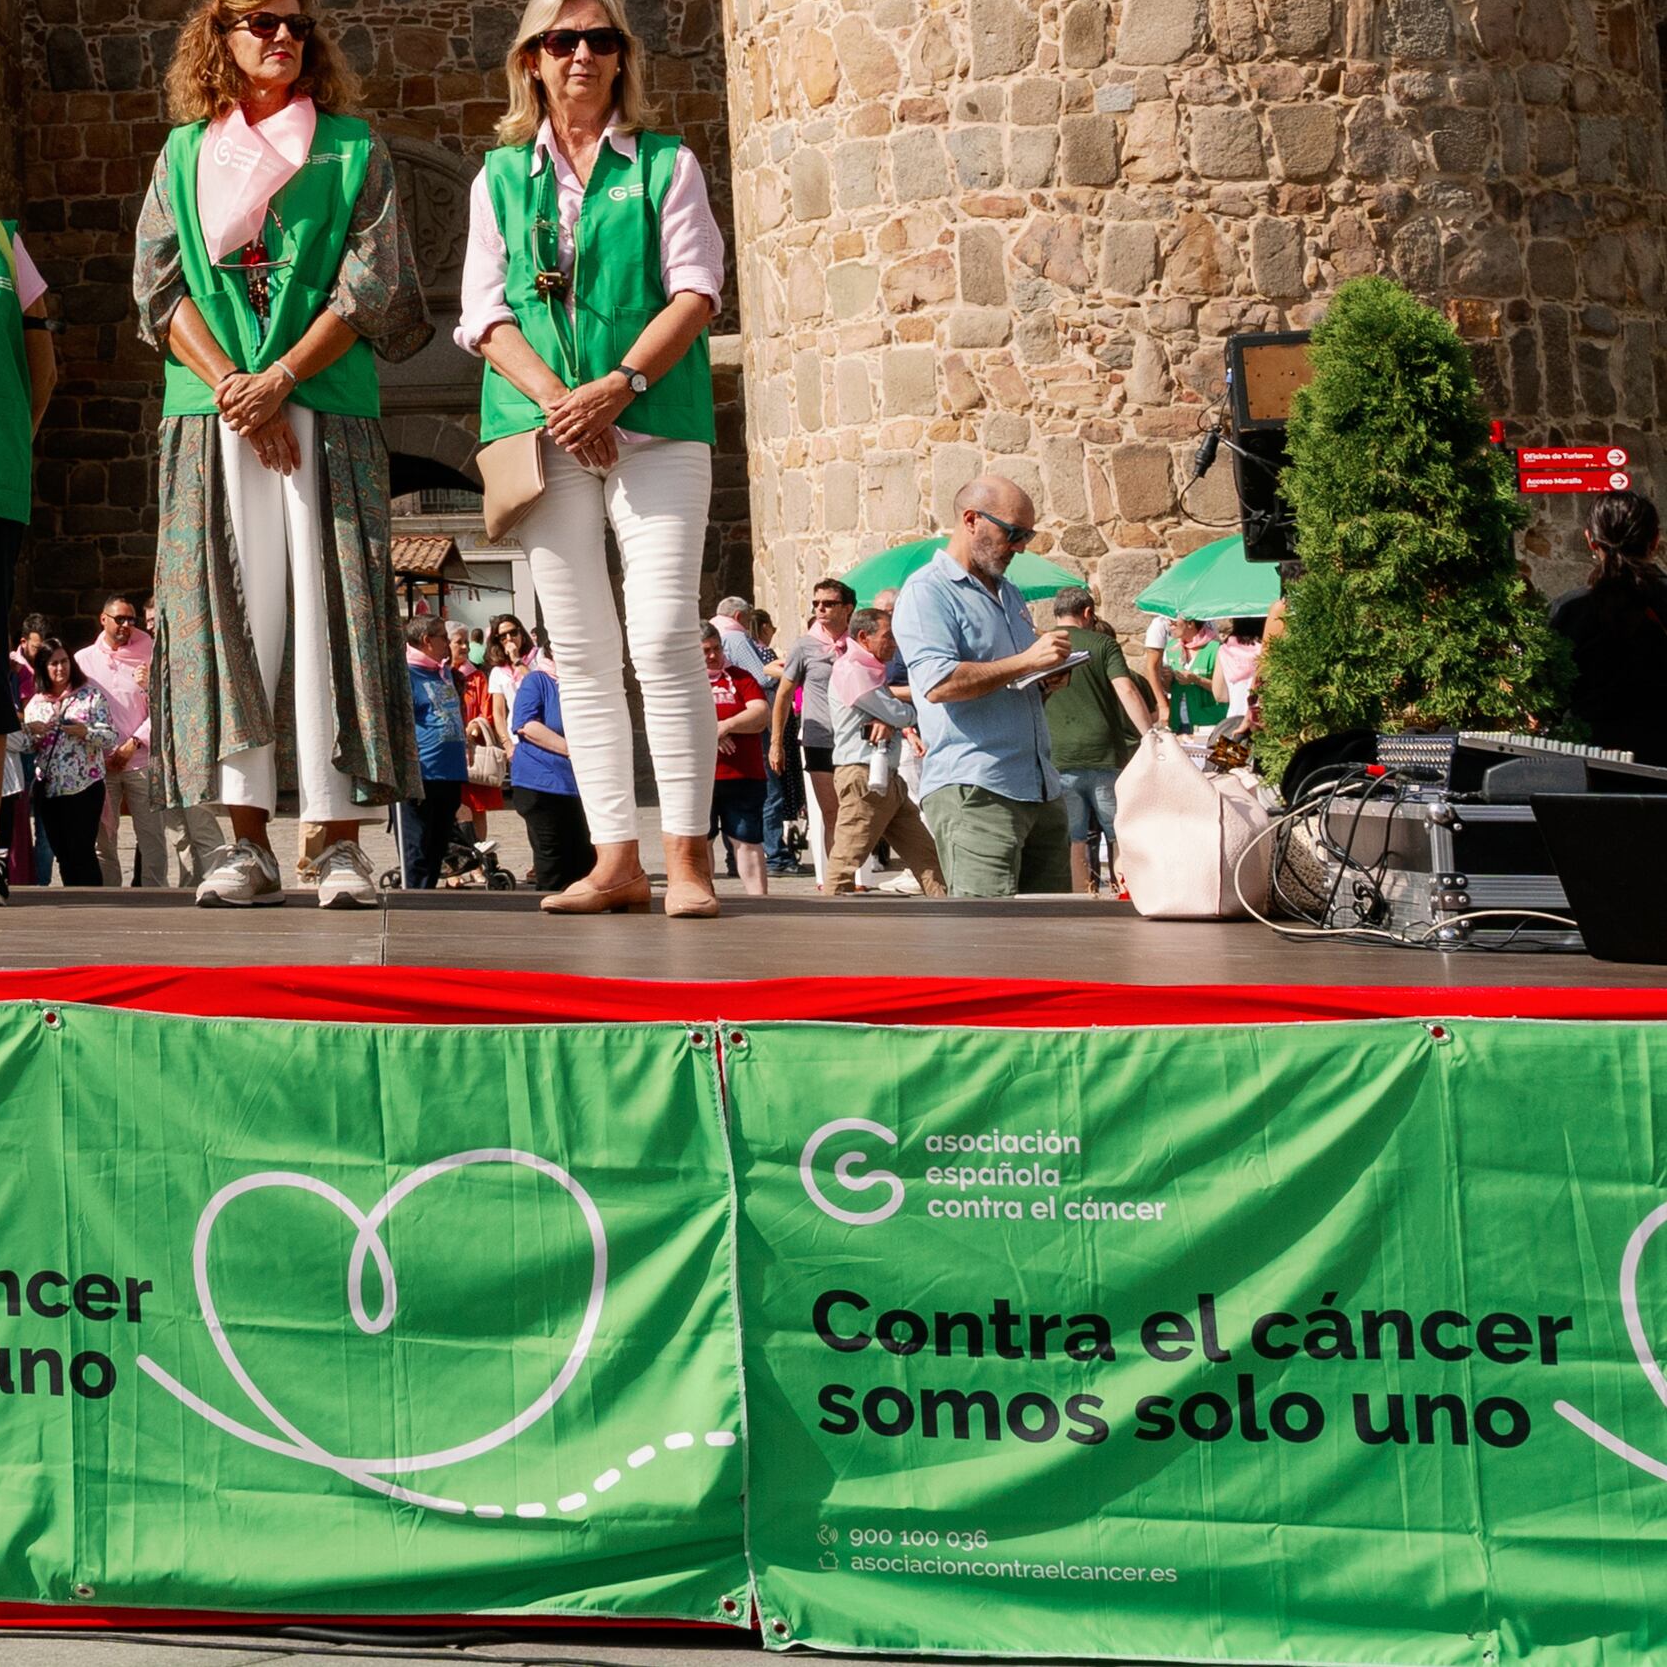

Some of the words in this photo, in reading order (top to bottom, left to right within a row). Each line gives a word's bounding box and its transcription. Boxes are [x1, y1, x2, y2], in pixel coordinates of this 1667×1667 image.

[925, 1128, 1081, 1155] asociación
[925, 1161, 1060, 1192] española
[927, 1195, 1023, 1220] contra
[1030, 1195, 1056, 1220] el
[1063, 1196, 1169, 1222] cáncer
[812, 1290, 1116, 1362] Contra
[1141, 1293, 1232, 1363] el
[1251, 1291, 1573, 1365] cáncer
[818, 1384, 1110, 1445] somos
[1134, 1373, 1324, 1443] solo
[1353, 1394, 1531, 1448] uno
[851, 1528, 893, 1547] 900
[901, 1528, 940, 1548] 100
[946, 1530, 989, 1552] 036
[849, 1552, 1178, 1586] asociacioncontraelcancer.es
